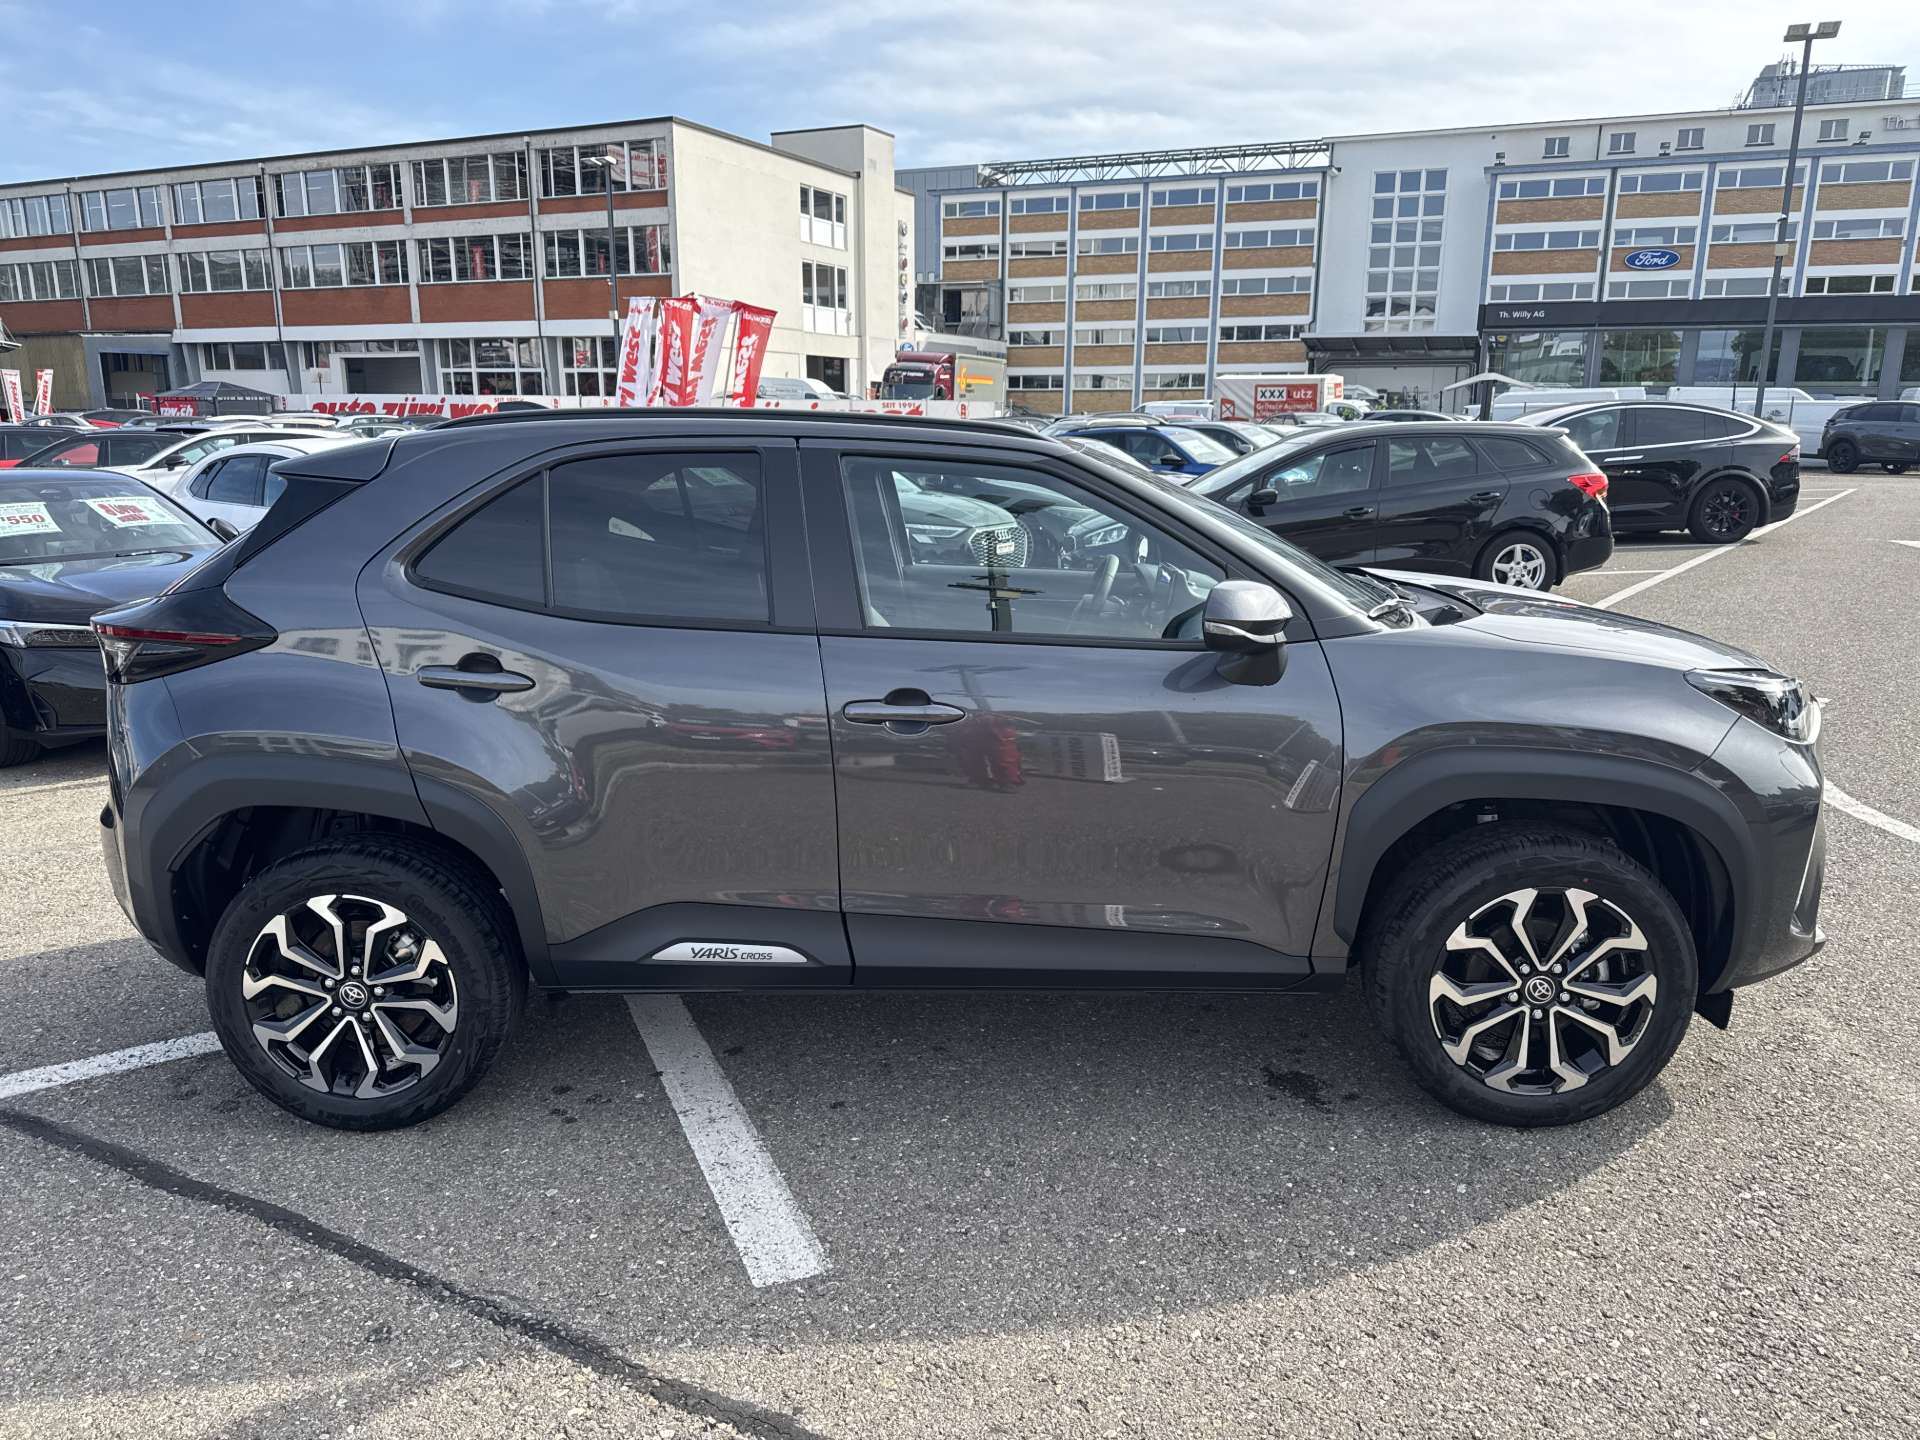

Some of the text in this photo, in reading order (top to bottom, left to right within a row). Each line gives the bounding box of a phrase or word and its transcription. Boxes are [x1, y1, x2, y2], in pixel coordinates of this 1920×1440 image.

[1635, 252, 1668, 266] Ford
[1512, 310, 1532, 320] Willy
[1533, 310, 1545, 318] AG
[622, 325, 641, 383] west
[690, 947, 773, 960] YARIS CROSS
